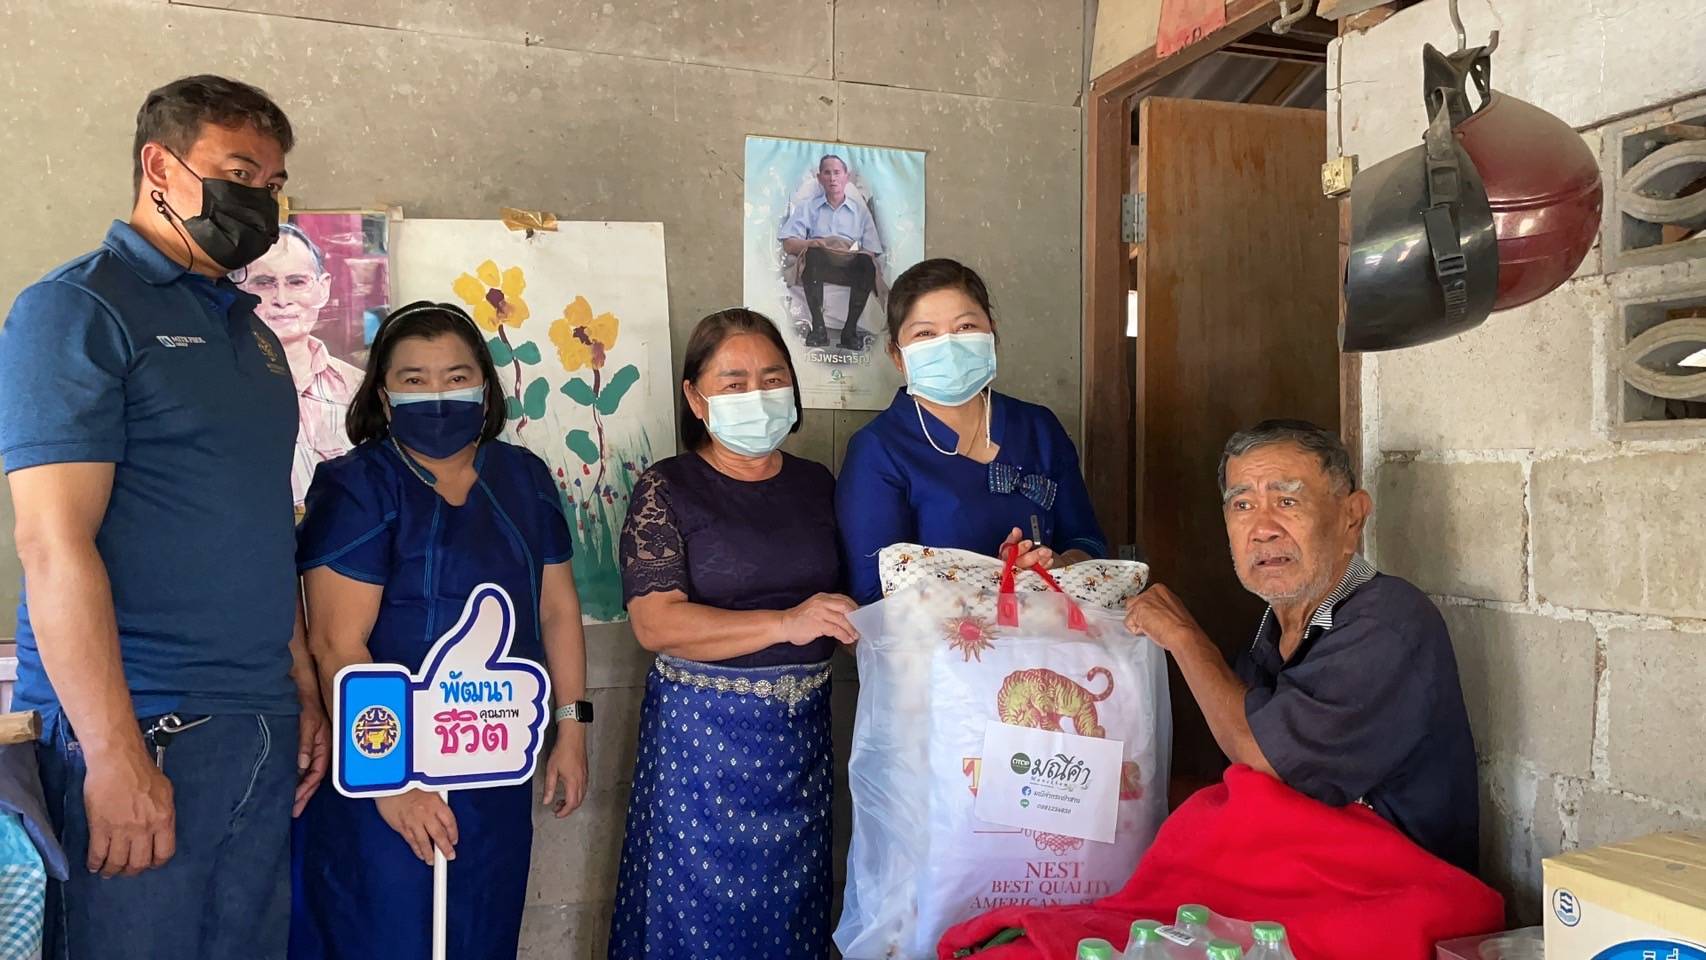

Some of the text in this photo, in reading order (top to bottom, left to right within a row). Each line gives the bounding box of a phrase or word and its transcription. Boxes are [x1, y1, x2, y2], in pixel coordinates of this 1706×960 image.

[807, 351, 872, 366] ทรงพระเจริญ
[439, 670, 513, 704] พัฒนา
[479, 709, 520, 723] คุณภาพ
[433, 708, 509, 754] ชีวิต
[1031, 753, 1091, 785] มณีคำ
[1025, 862, 1081, 879] NEST
[991, 880, 1111, 895] BEST QUALITY
